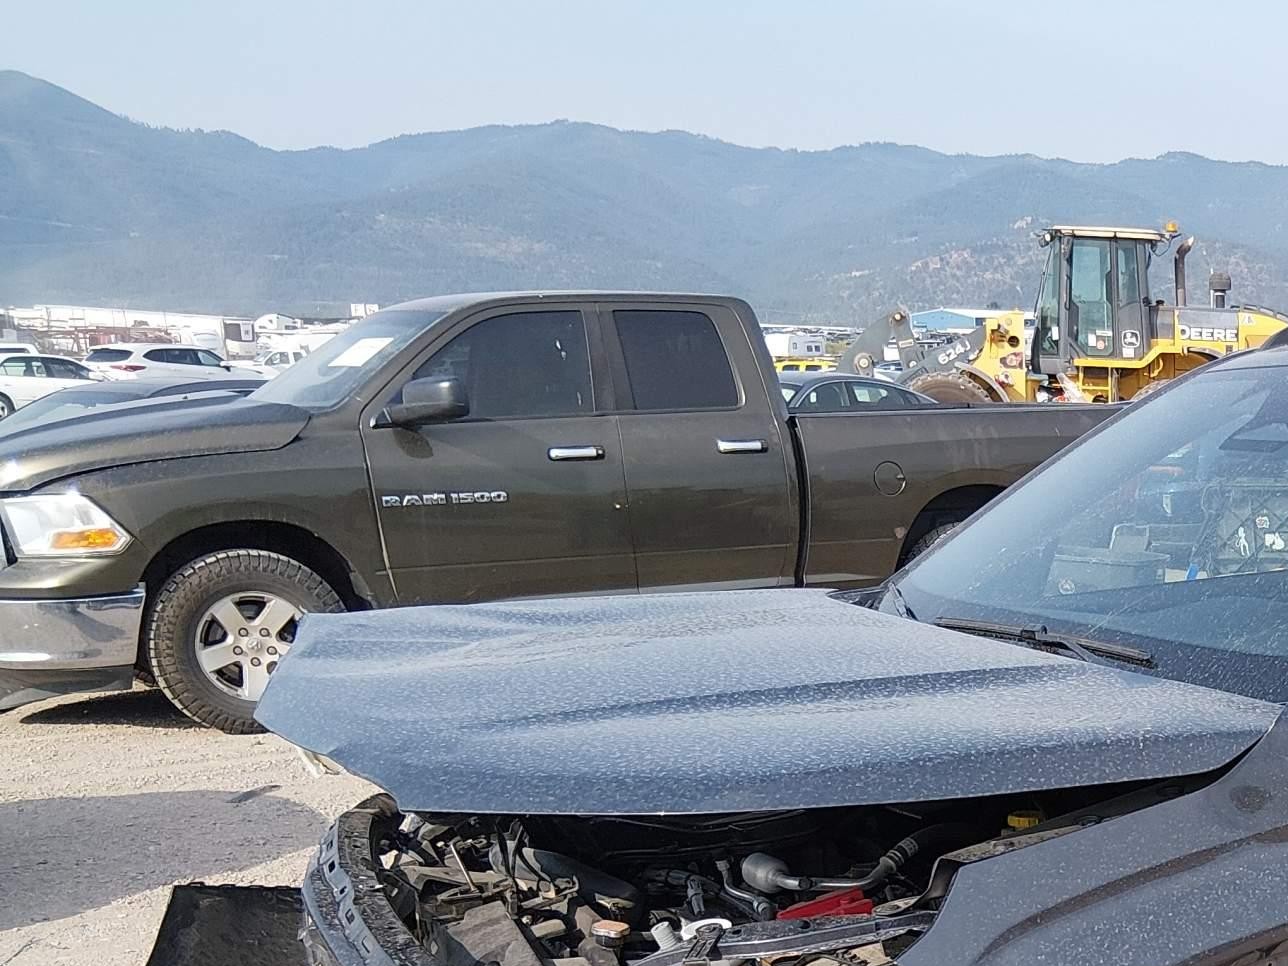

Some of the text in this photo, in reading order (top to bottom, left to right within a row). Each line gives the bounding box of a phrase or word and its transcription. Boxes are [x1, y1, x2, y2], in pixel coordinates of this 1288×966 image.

[1177, 324, 1238, 342] DEERE
[937, 339, 971, 365] 624J
[382, 491, 508, 507] RAM 1500
